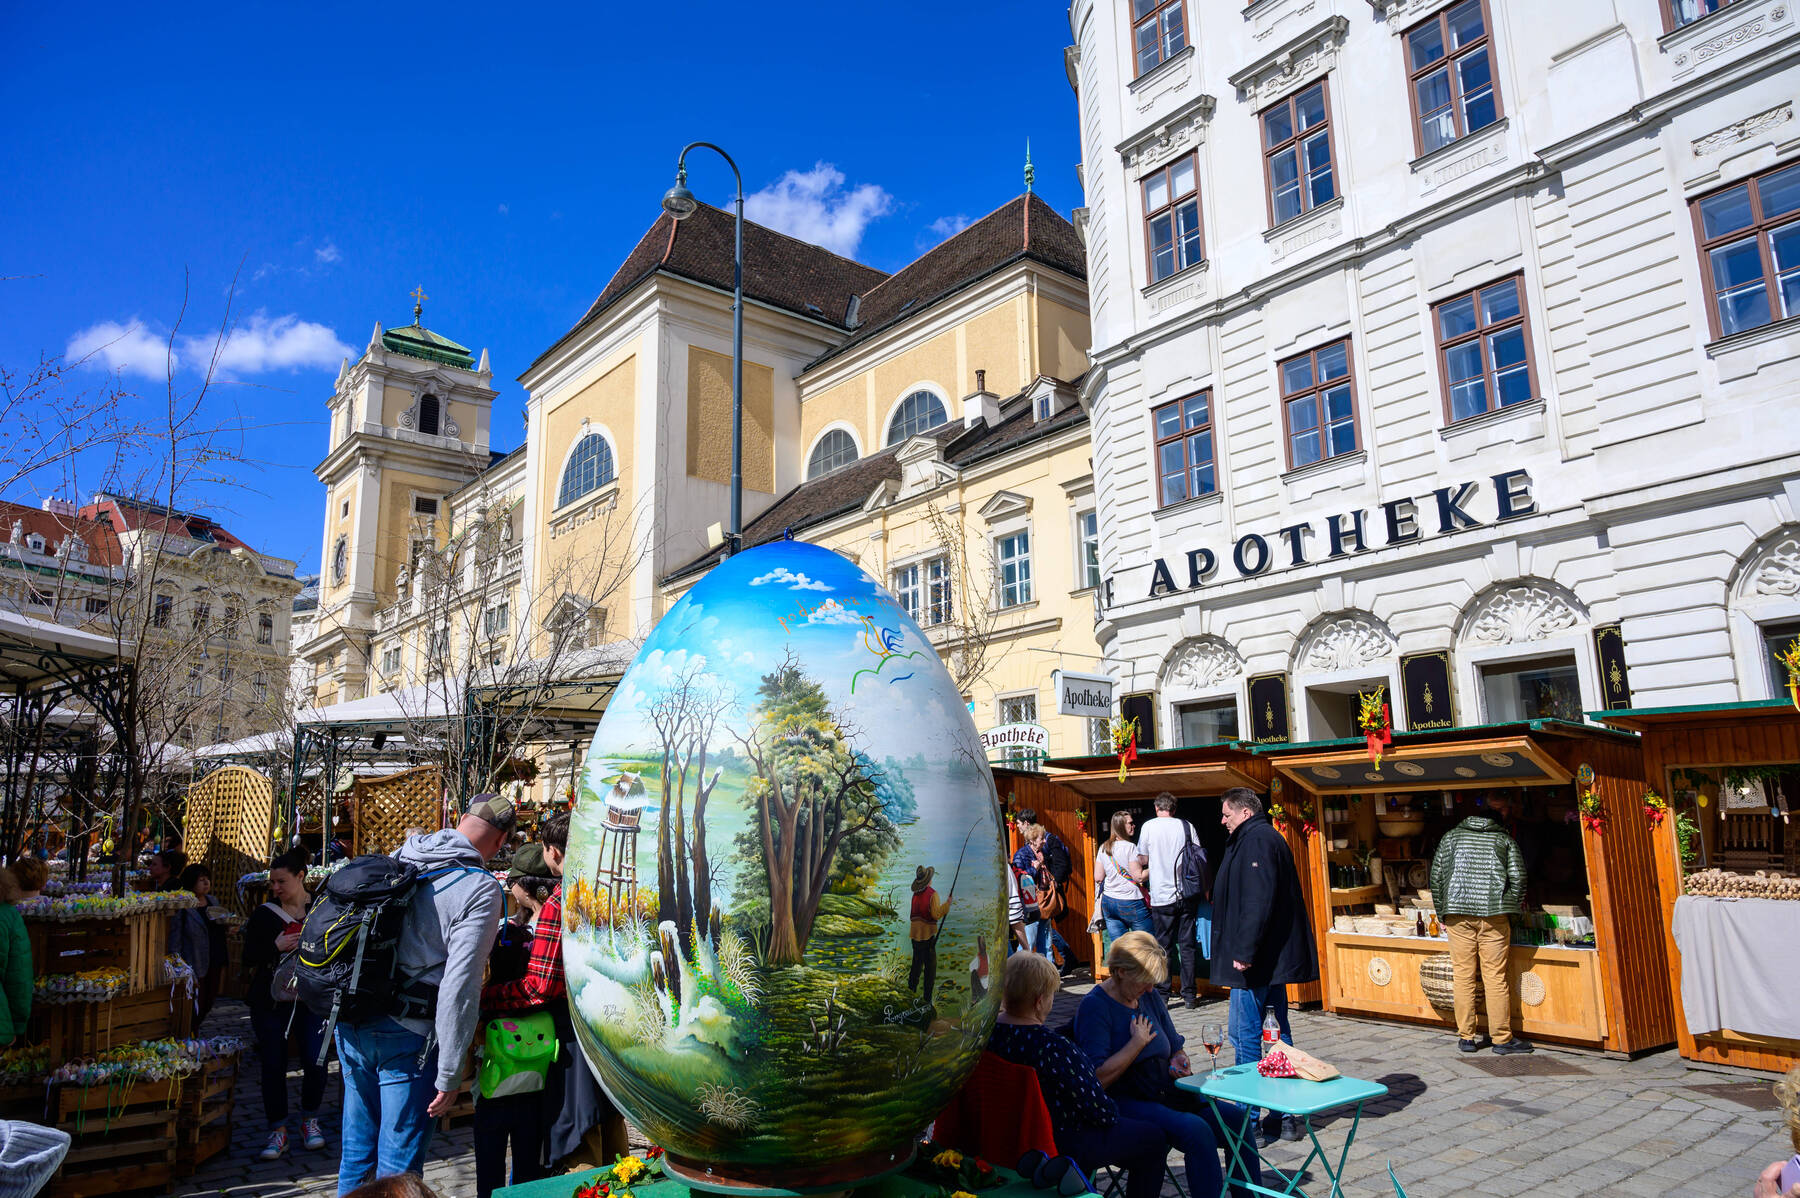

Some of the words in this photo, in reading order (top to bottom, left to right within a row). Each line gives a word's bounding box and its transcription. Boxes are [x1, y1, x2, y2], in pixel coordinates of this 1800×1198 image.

[1148, 468, 1537, 597] APOTHEKE
[777, 596, 861, 635] podravina
[1063, 687, 1111, 709] Apotheke
[1412, 719, 1451, 731] Apotheke
[979, 726, 1045, 748] Apotheke
[1580, 767, 1592, 777] 18
